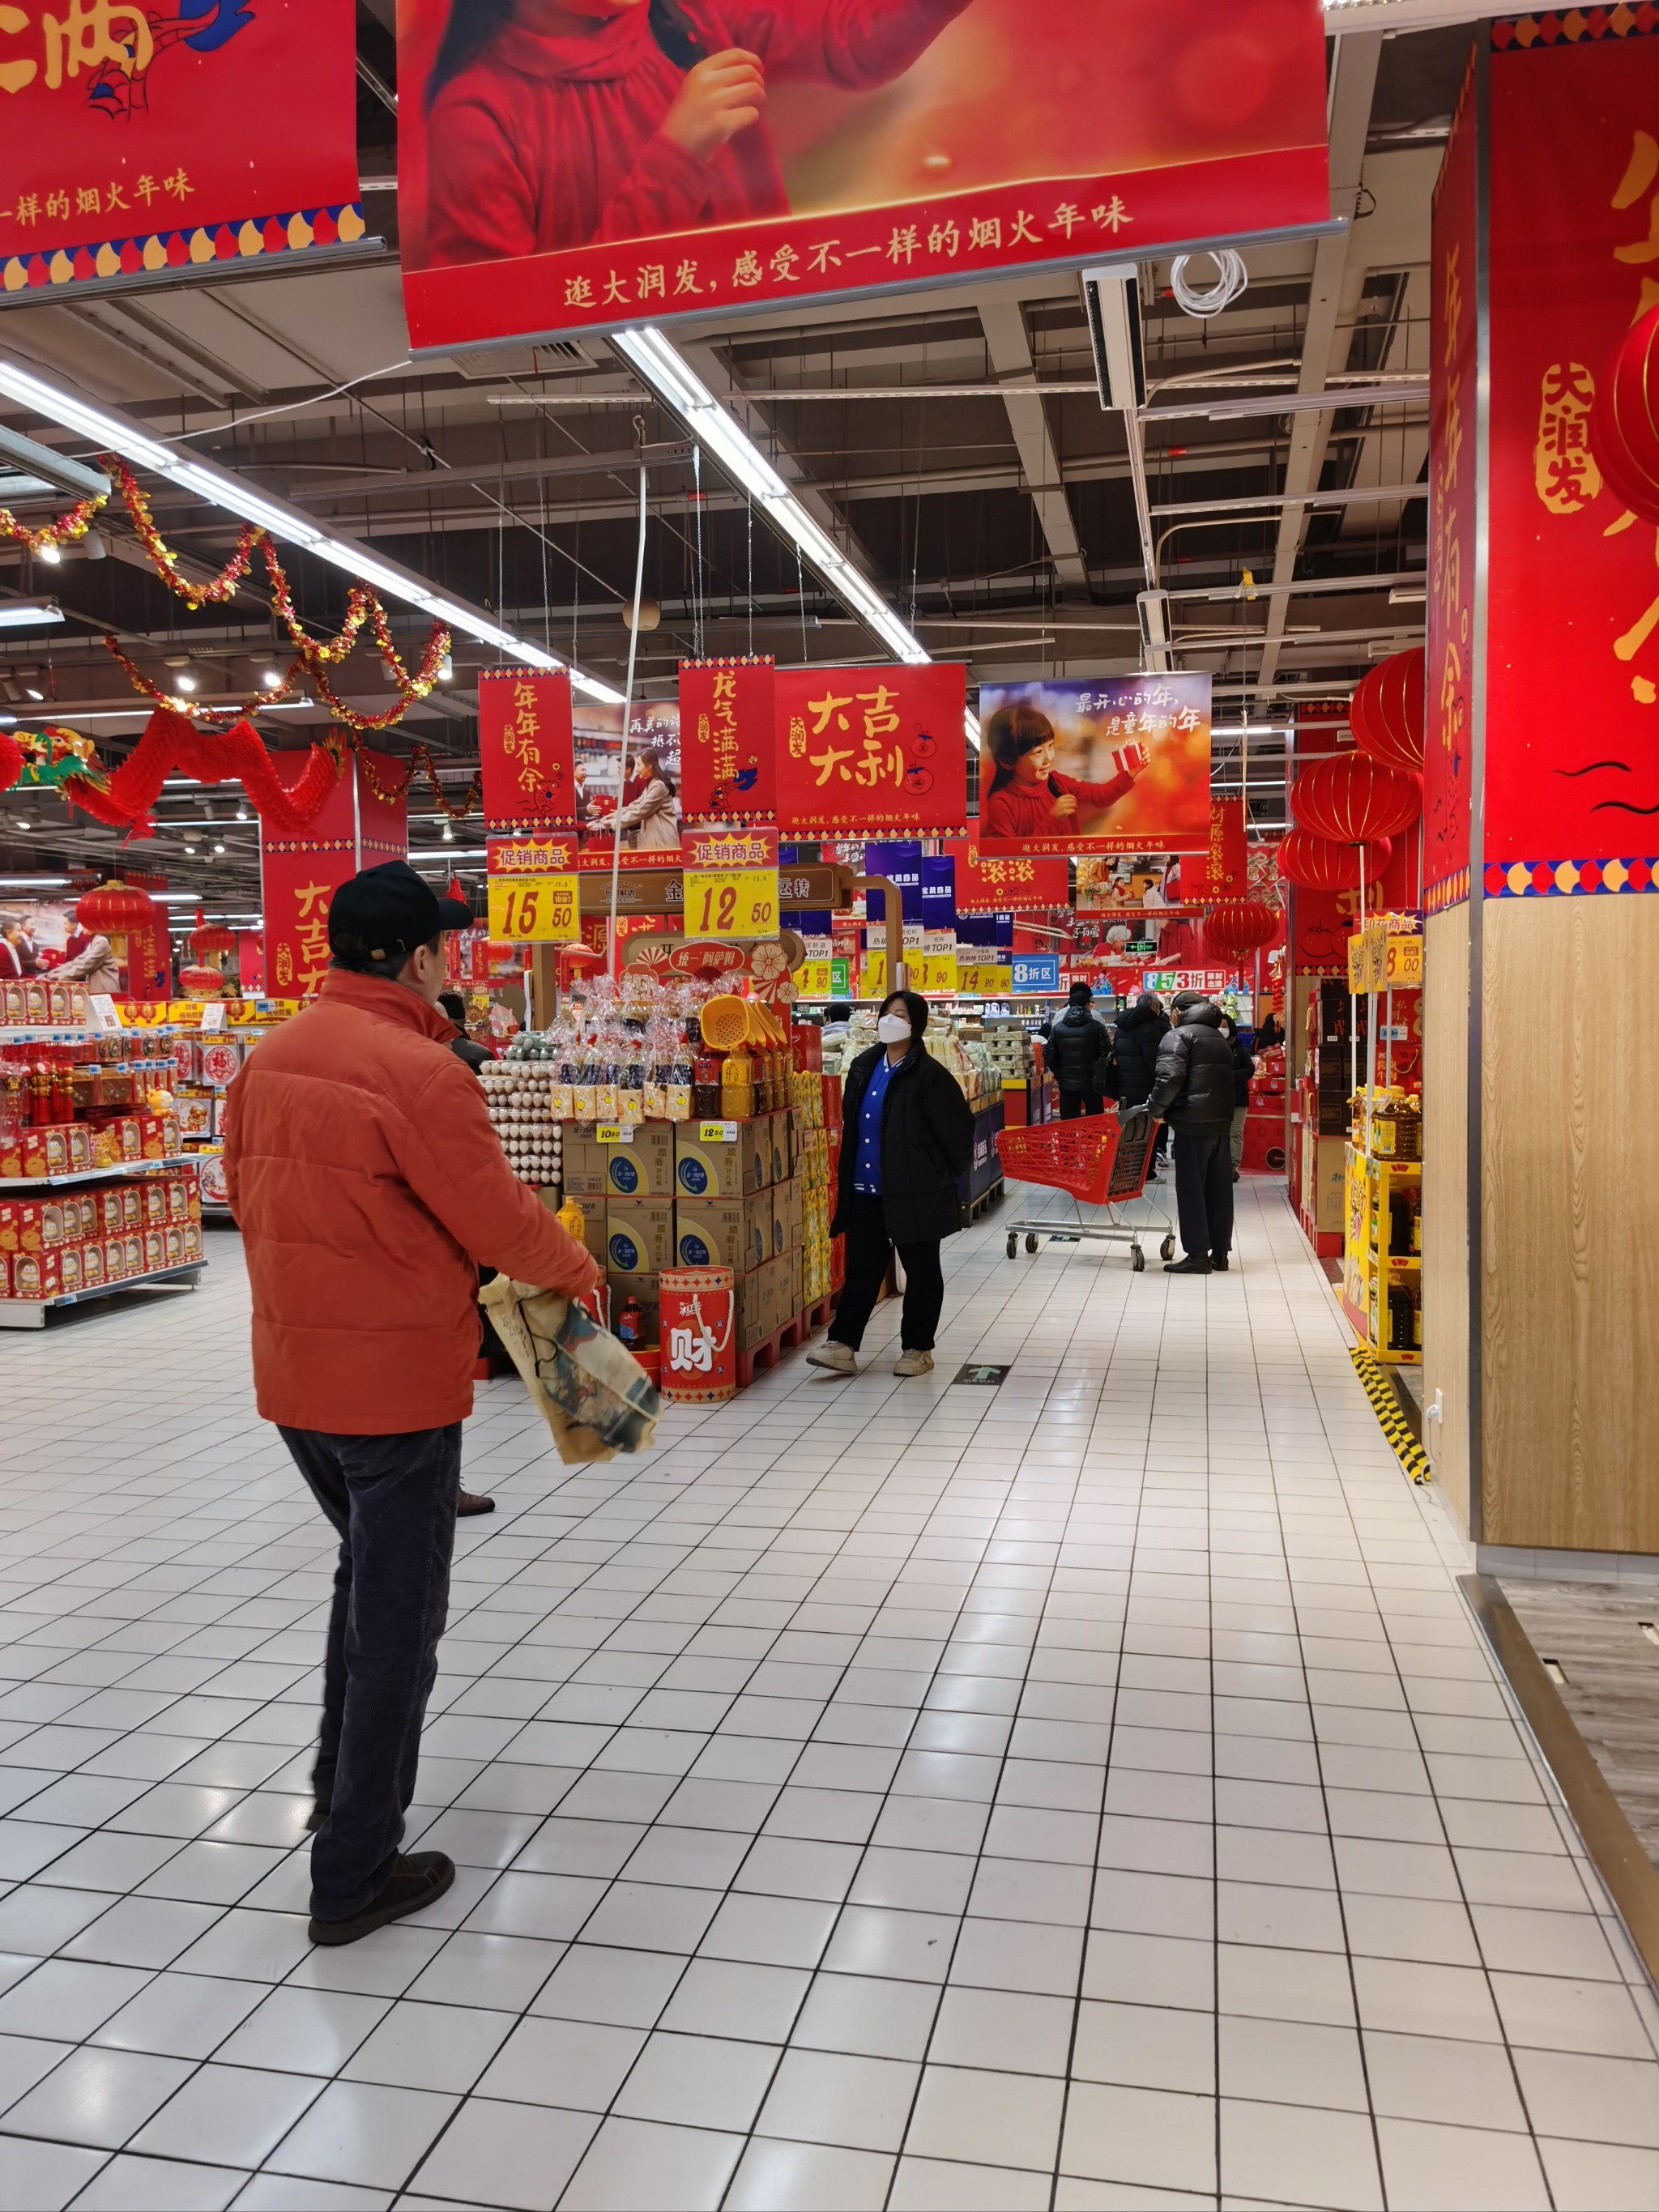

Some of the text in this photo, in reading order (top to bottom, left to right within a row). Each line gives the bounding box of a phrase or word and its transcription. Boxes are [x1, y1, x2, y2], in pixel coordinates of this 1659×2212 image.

[1542, 366, 1595, 507] 大润发
[807, 684, 900, 738] 大吉
[1105, 705, 1201, 737] 是童年的年
[699, 714, 709, 743] 大润发
[712, 670, 740, 781] 龙气满满
[504, 724, 514, 752] 大润发
[513, 680, 545, 794] 年年有余
[650, 732, 680, 748] 抵不
[791, 716, 805, 757] 大润发
[809, 739, 904, 788] 大利
[500, 848, 565, 866] 促销商品
[578, 855, 683, 867] 大润发，受不一样的烟火
[696, 842, 765, 861] 促销商品
[665, 879, 683, 901] 金
[502, 890, 539, 935] 15
[552, 907, 572, 927] 50
[699, 885, 737, 931] 12
[751, 902, 772, 923] 50
[902, 936, 920, 945] OP1
[932, 943, 953, 953] TOP1
[276, 943, 292, 986] 大润发
[702, 951, 735, 966] 阿萨姆
[977, 954, 995, 962] TOP1
[1404, 958, 1419, 972] 00
[817, 977, 828, 988] 90
[961, 970, 979, 991] 14
[1013, 963, 1051, 983] 8折区
[670, 1325, 717, 1372] 财
